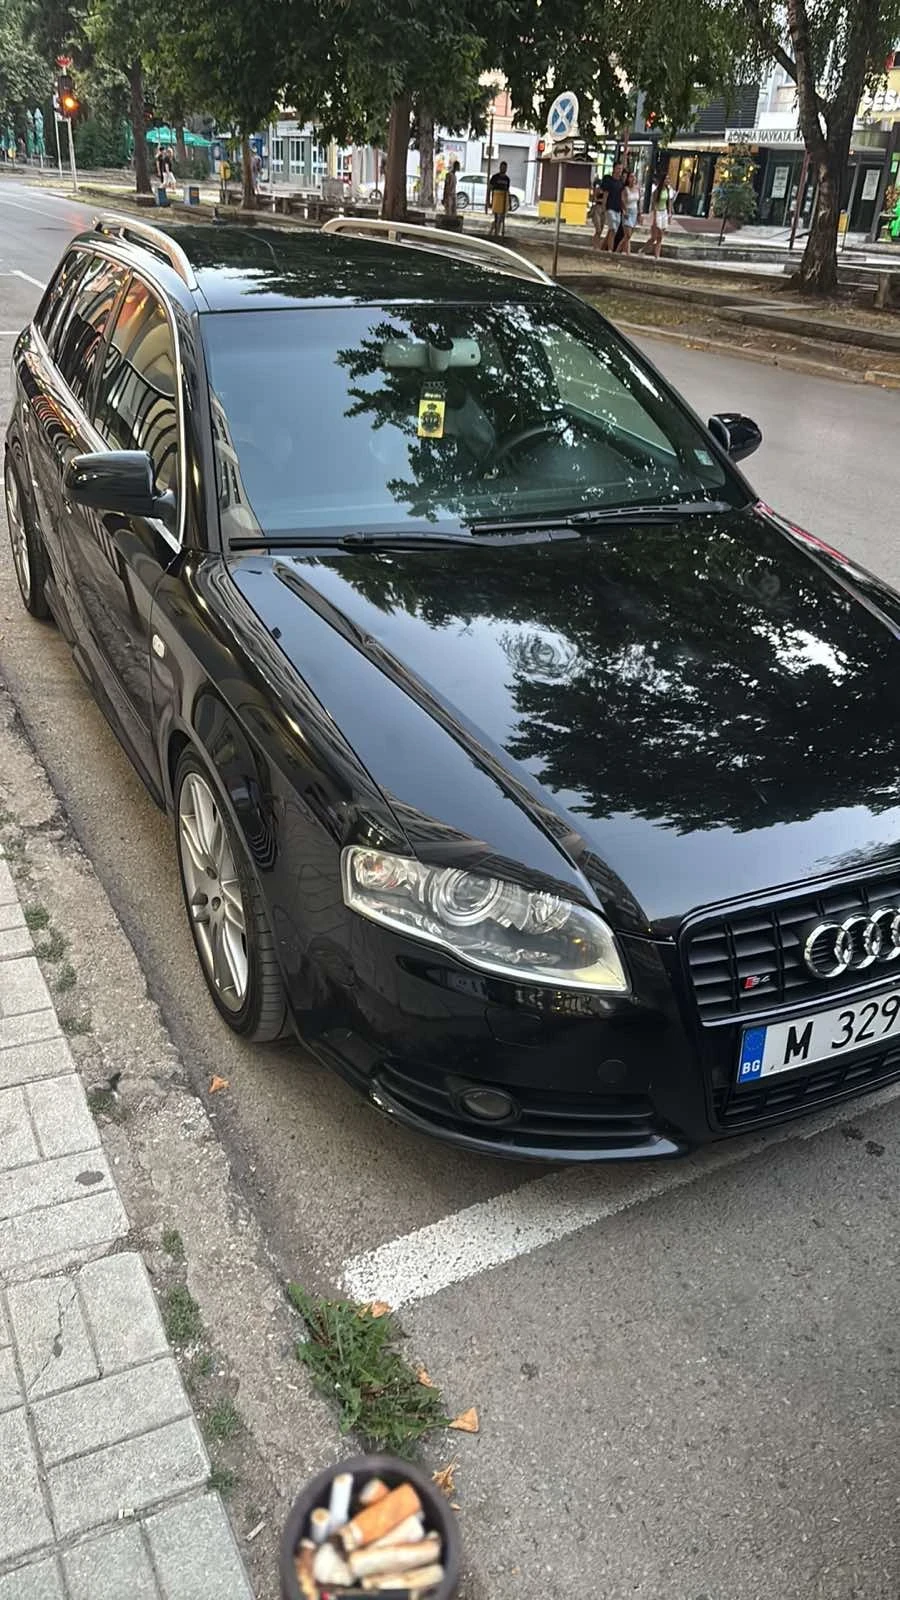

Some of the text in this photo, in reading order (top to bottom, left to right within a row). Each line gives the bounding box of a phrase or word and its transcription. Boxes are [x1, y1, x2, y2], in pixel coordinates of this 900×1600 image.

[783, 994, 900, 1065] M 329
[741, 1059, 761, 1075] BG
